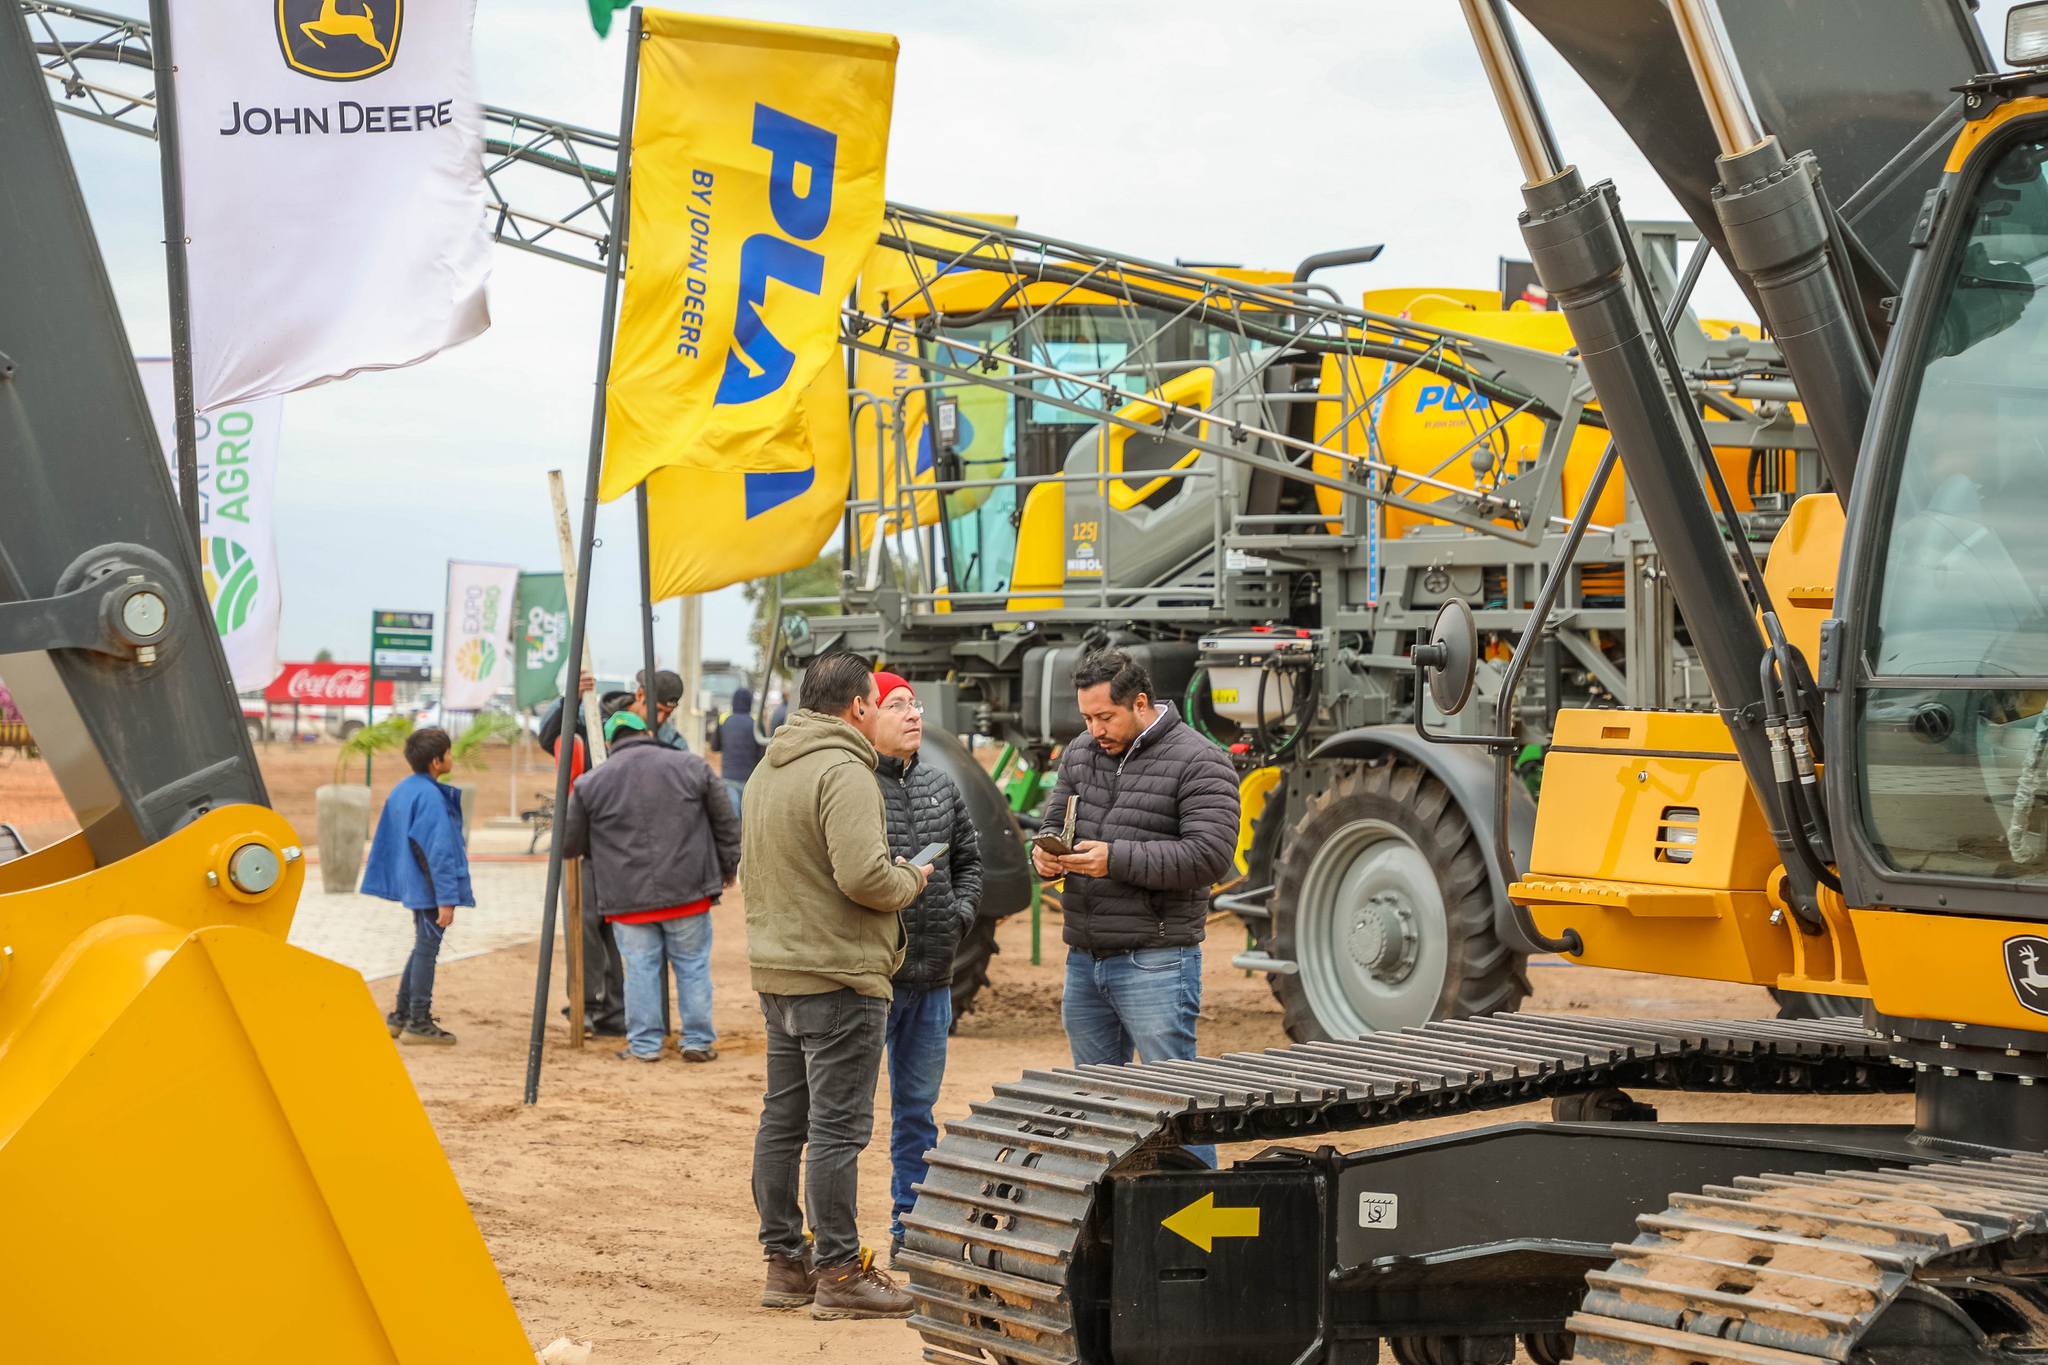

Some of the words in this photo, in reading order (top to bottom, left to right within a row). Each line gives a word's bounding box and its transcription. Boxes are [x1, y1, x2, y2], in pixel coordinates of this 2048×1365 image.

[219, 101, 330, 136] JOHN
[338, 98, 454, 135] DEERE
[690, 168, 714, 206] BY
[686, 205, 711, 274] JOHN
[712, 101, 838, 408] PLA
[676, 277, 706, 359] DEERE
[1415, 384, 1489, 413] PLA
[215, 411, 254, 524] AGRO
[1072, 521, 1098, 543] 125J
[1067, 559, 1104, 571] NIBOL
